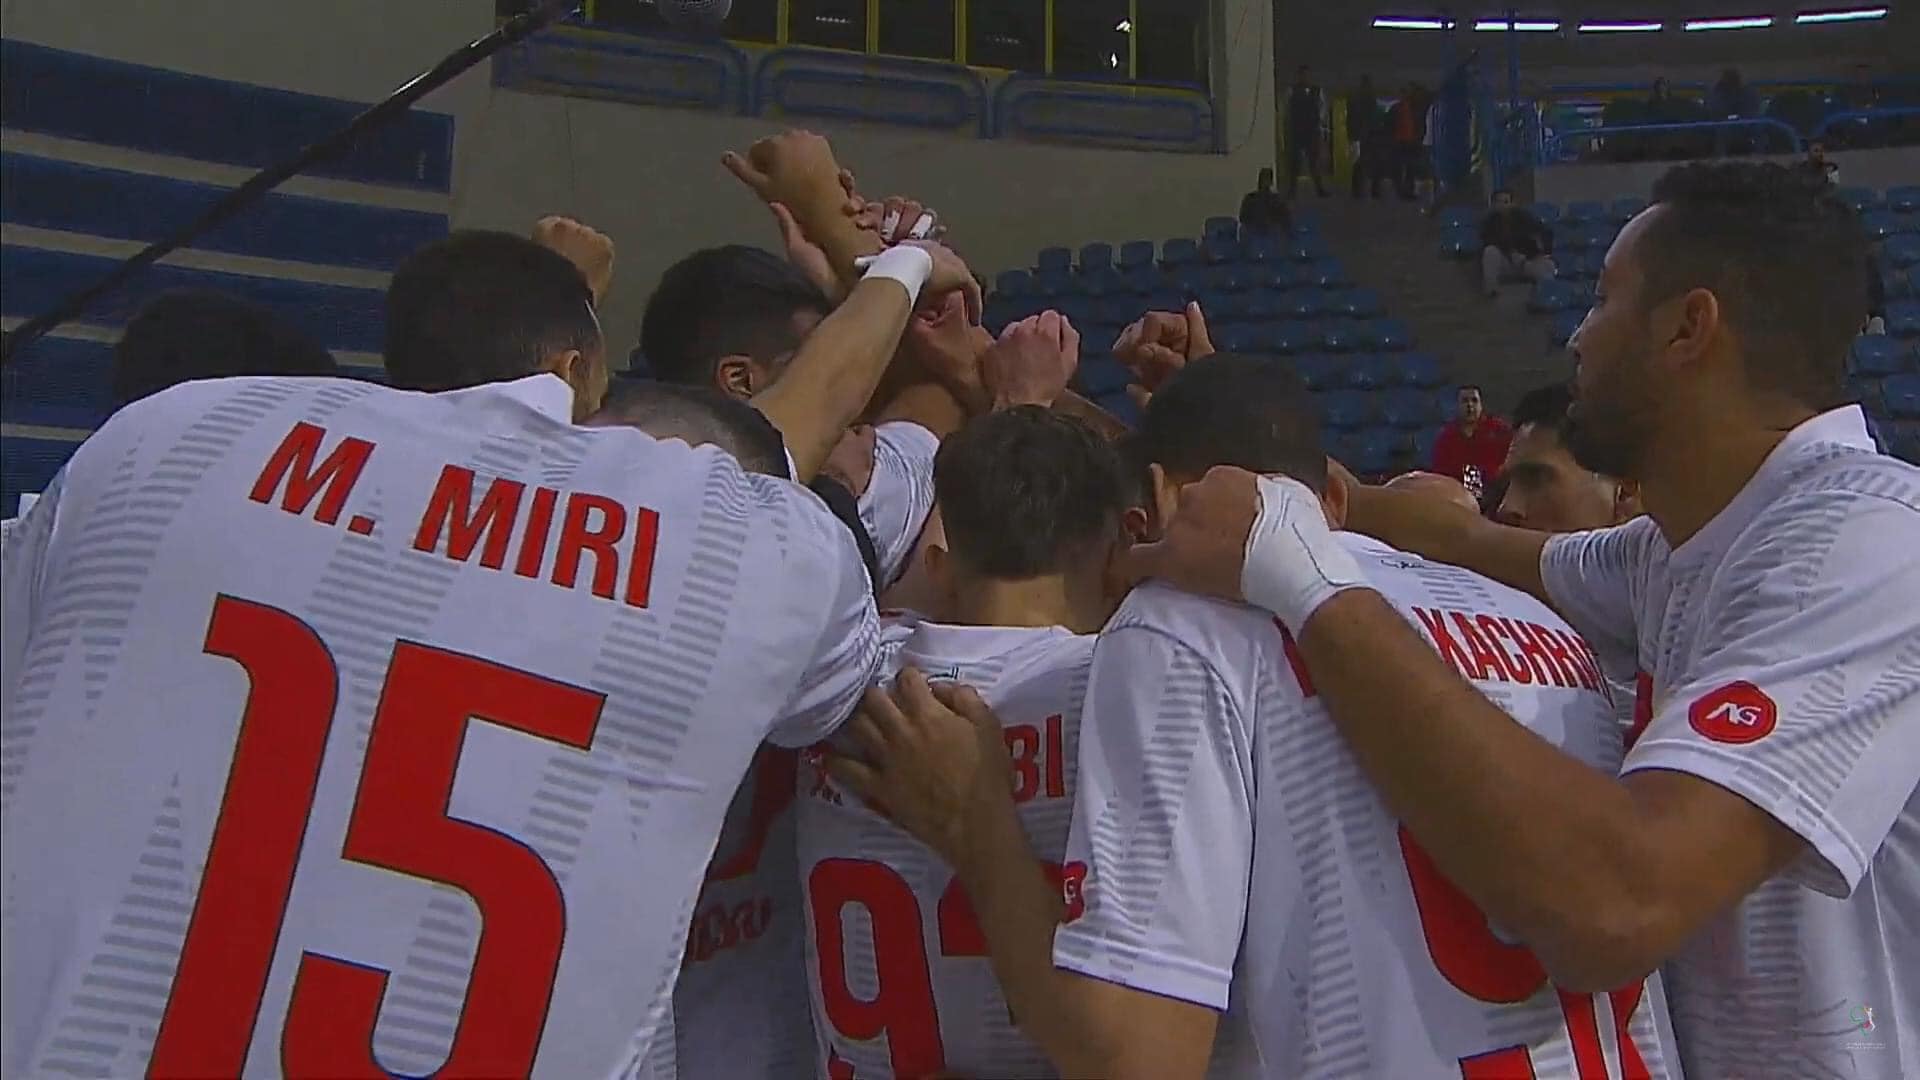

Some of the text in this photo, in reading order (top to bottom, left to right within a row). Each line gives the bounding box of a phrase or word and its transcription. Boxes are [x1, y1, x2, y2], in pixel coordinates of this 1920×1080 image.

[249, 421, 660, 608] M. MIRI
[144, 592, 607, 1080] 15
